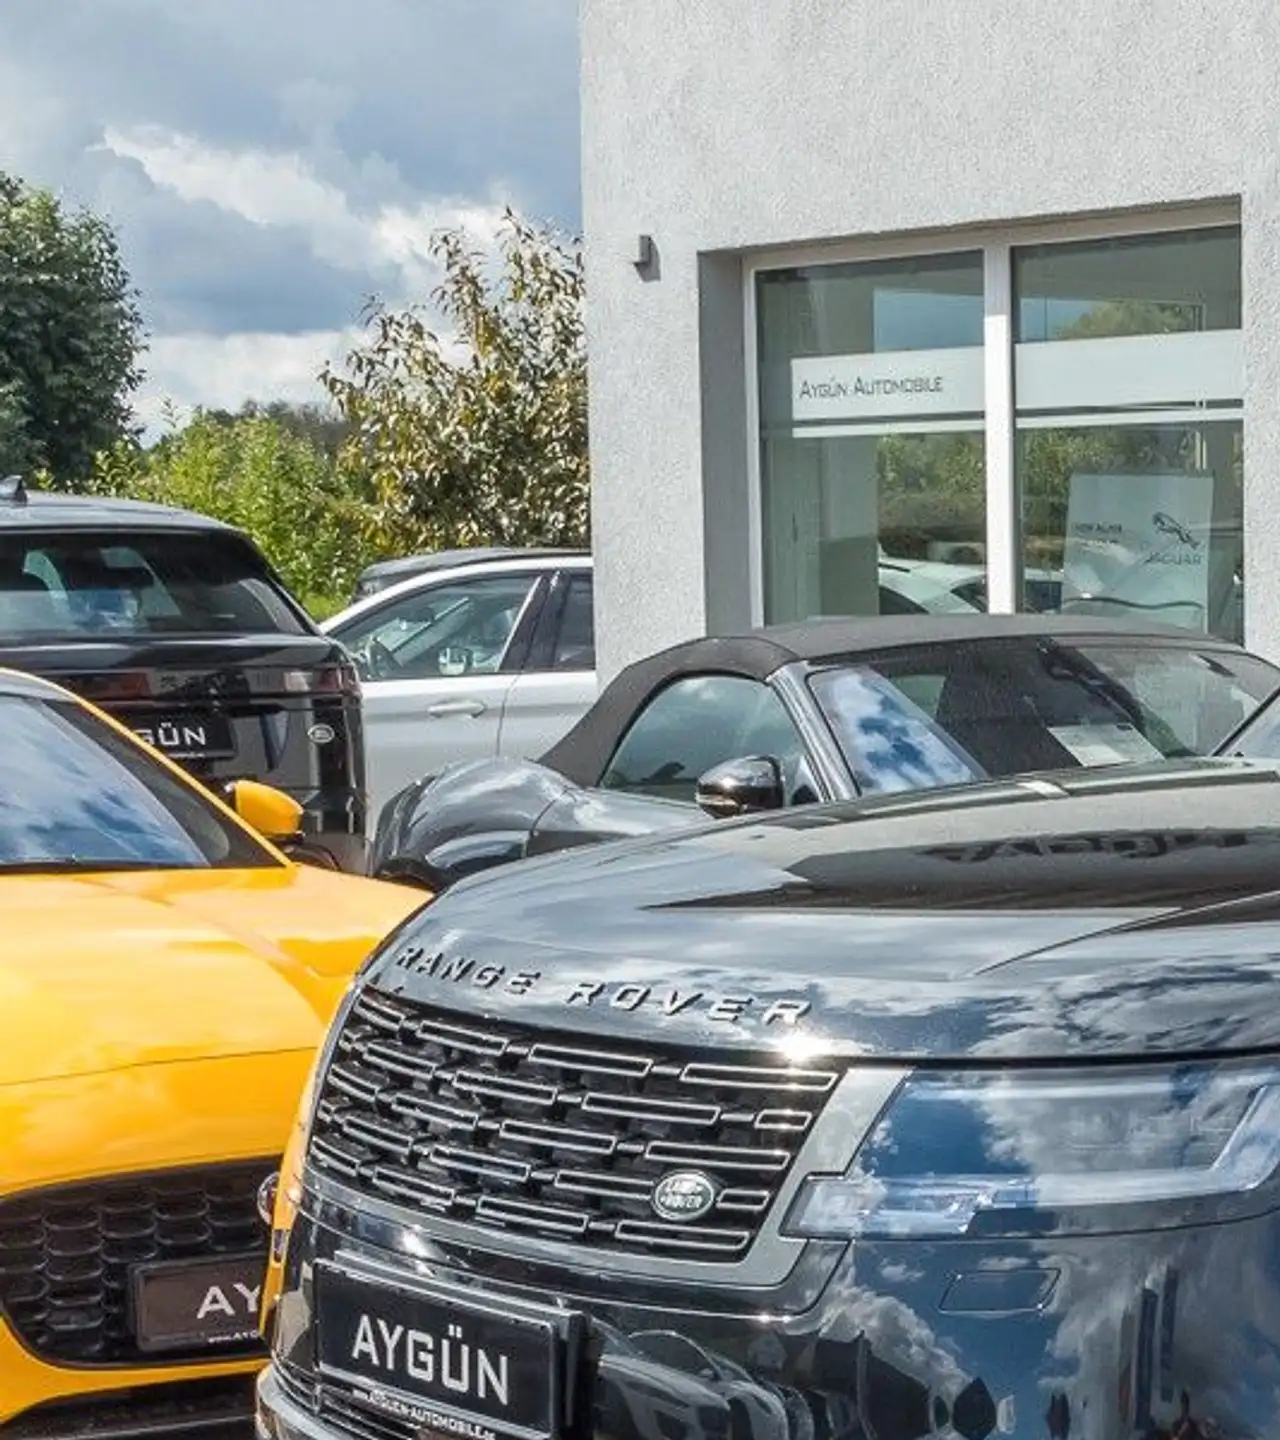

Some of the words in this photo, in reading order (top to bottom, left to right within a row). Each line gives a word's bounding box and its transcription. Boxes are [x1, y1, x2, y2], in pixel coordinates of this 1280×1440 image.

[396, 946, 541, 996] RANGE
[566, 982, 812, 1027] ROVER
[352, 1313, 508, 1406] AYGÜN
